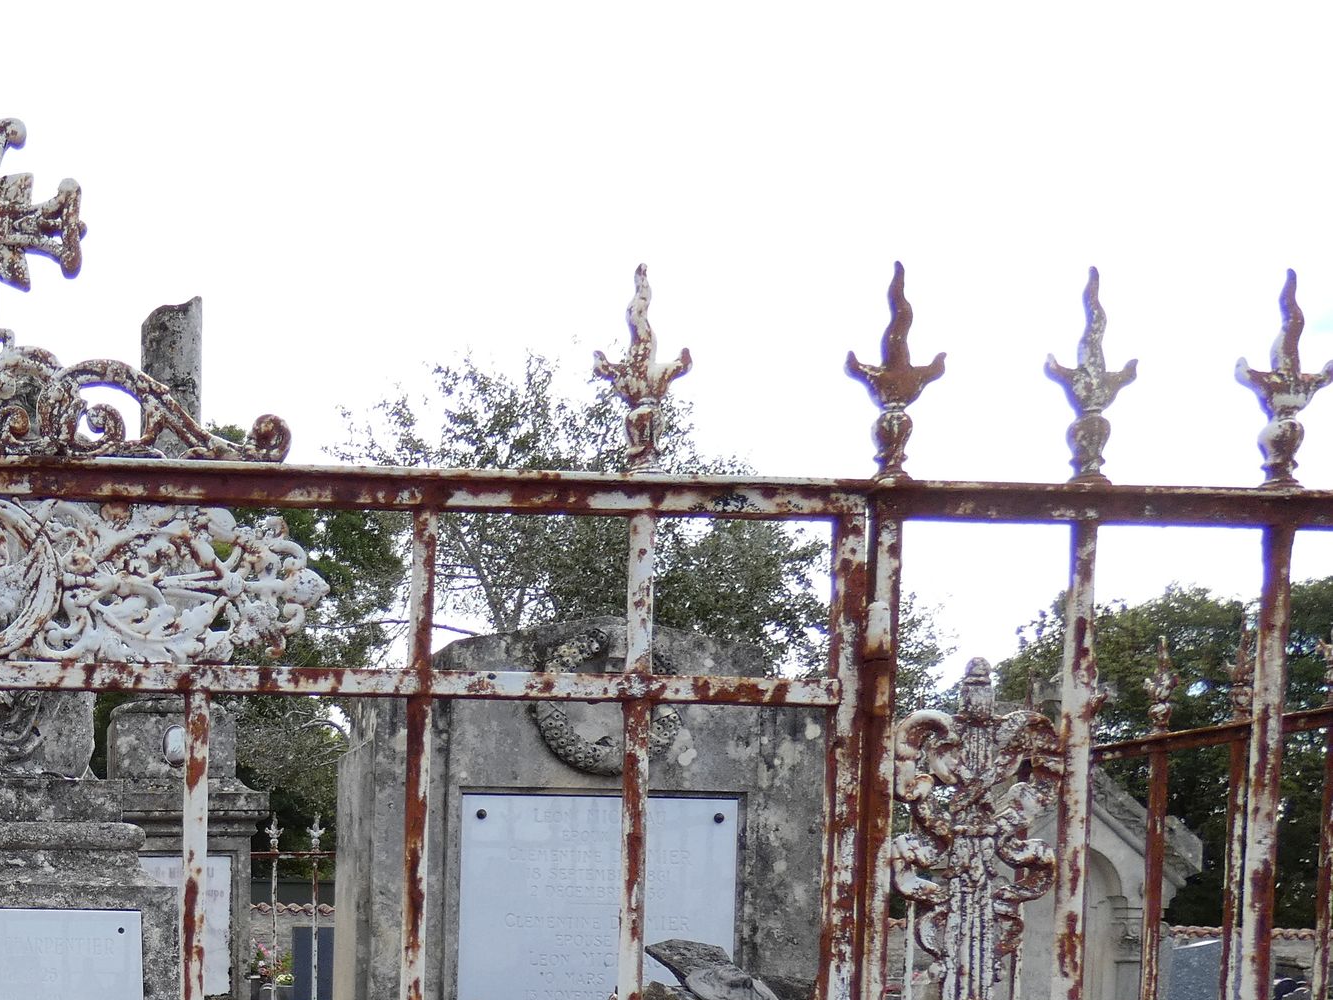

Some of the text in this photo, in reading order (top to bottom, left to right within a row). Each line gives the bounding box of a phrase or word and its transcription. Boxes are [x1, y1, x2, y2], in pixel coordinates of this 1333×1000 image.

[508, 846, 603, 863] CLEMENTINE
[548, 867, 623, 881] SEPTEMB
[529, 884, 539, 896] 2
[545, 884, 624, 898] DECEMBR
[505, 912, 602, 930] CLEMENTINE
[555, 934, 613, 947] EPOUSE
[564, 972, 606, 985] MARS
